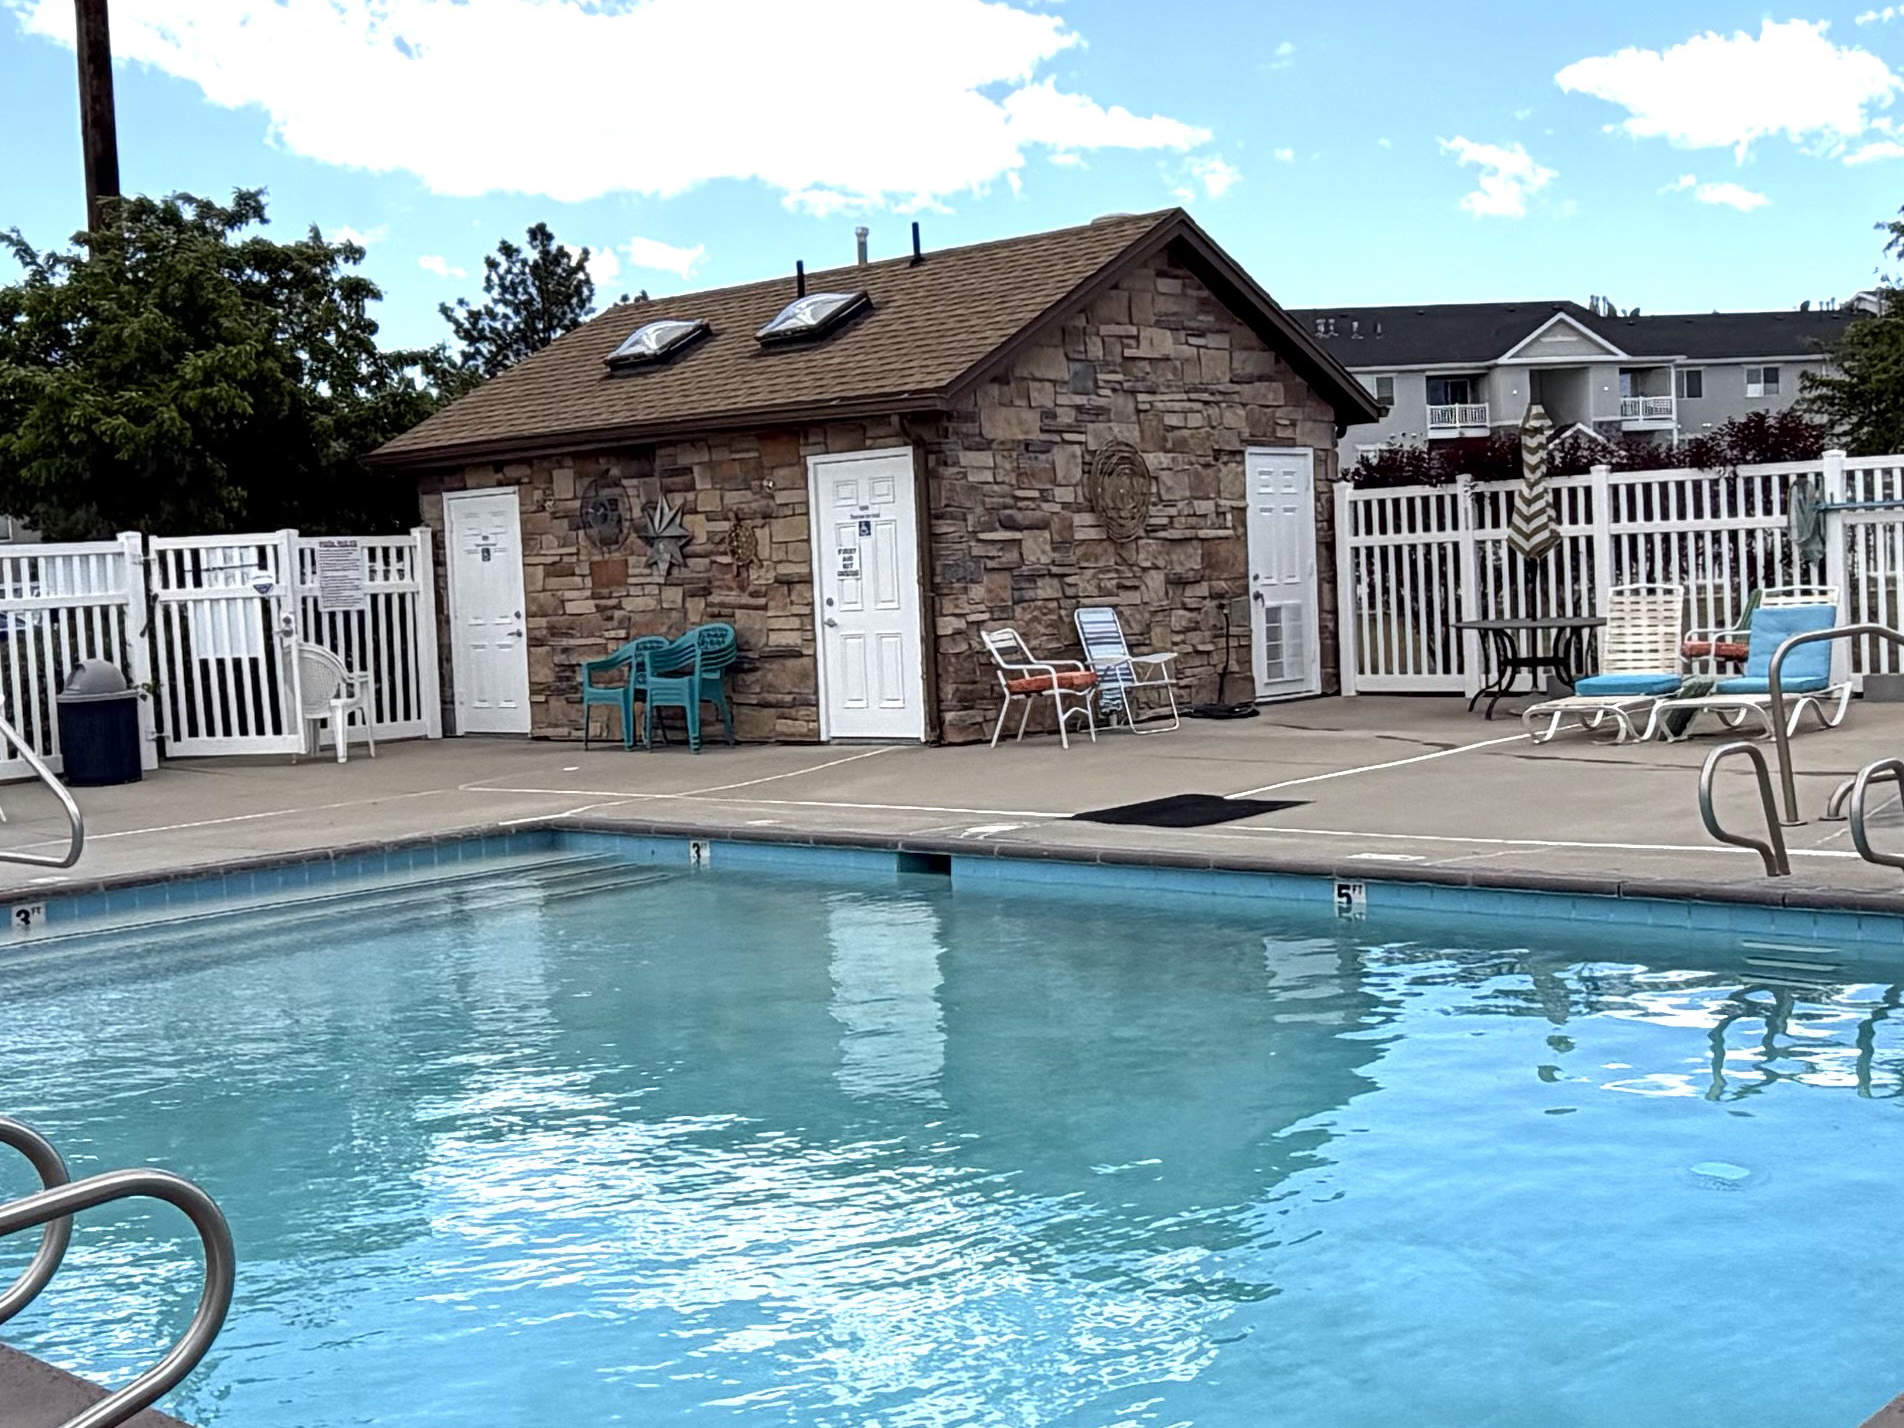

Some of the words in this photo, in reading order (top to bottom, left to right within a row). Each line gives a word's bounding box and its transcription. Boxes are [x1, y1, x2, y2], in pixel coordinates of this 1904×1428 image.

[1337, 884, 1352, 904] 5
[1352, 884, 1363, 895] FT
[31, 906, 41, 916] FT
